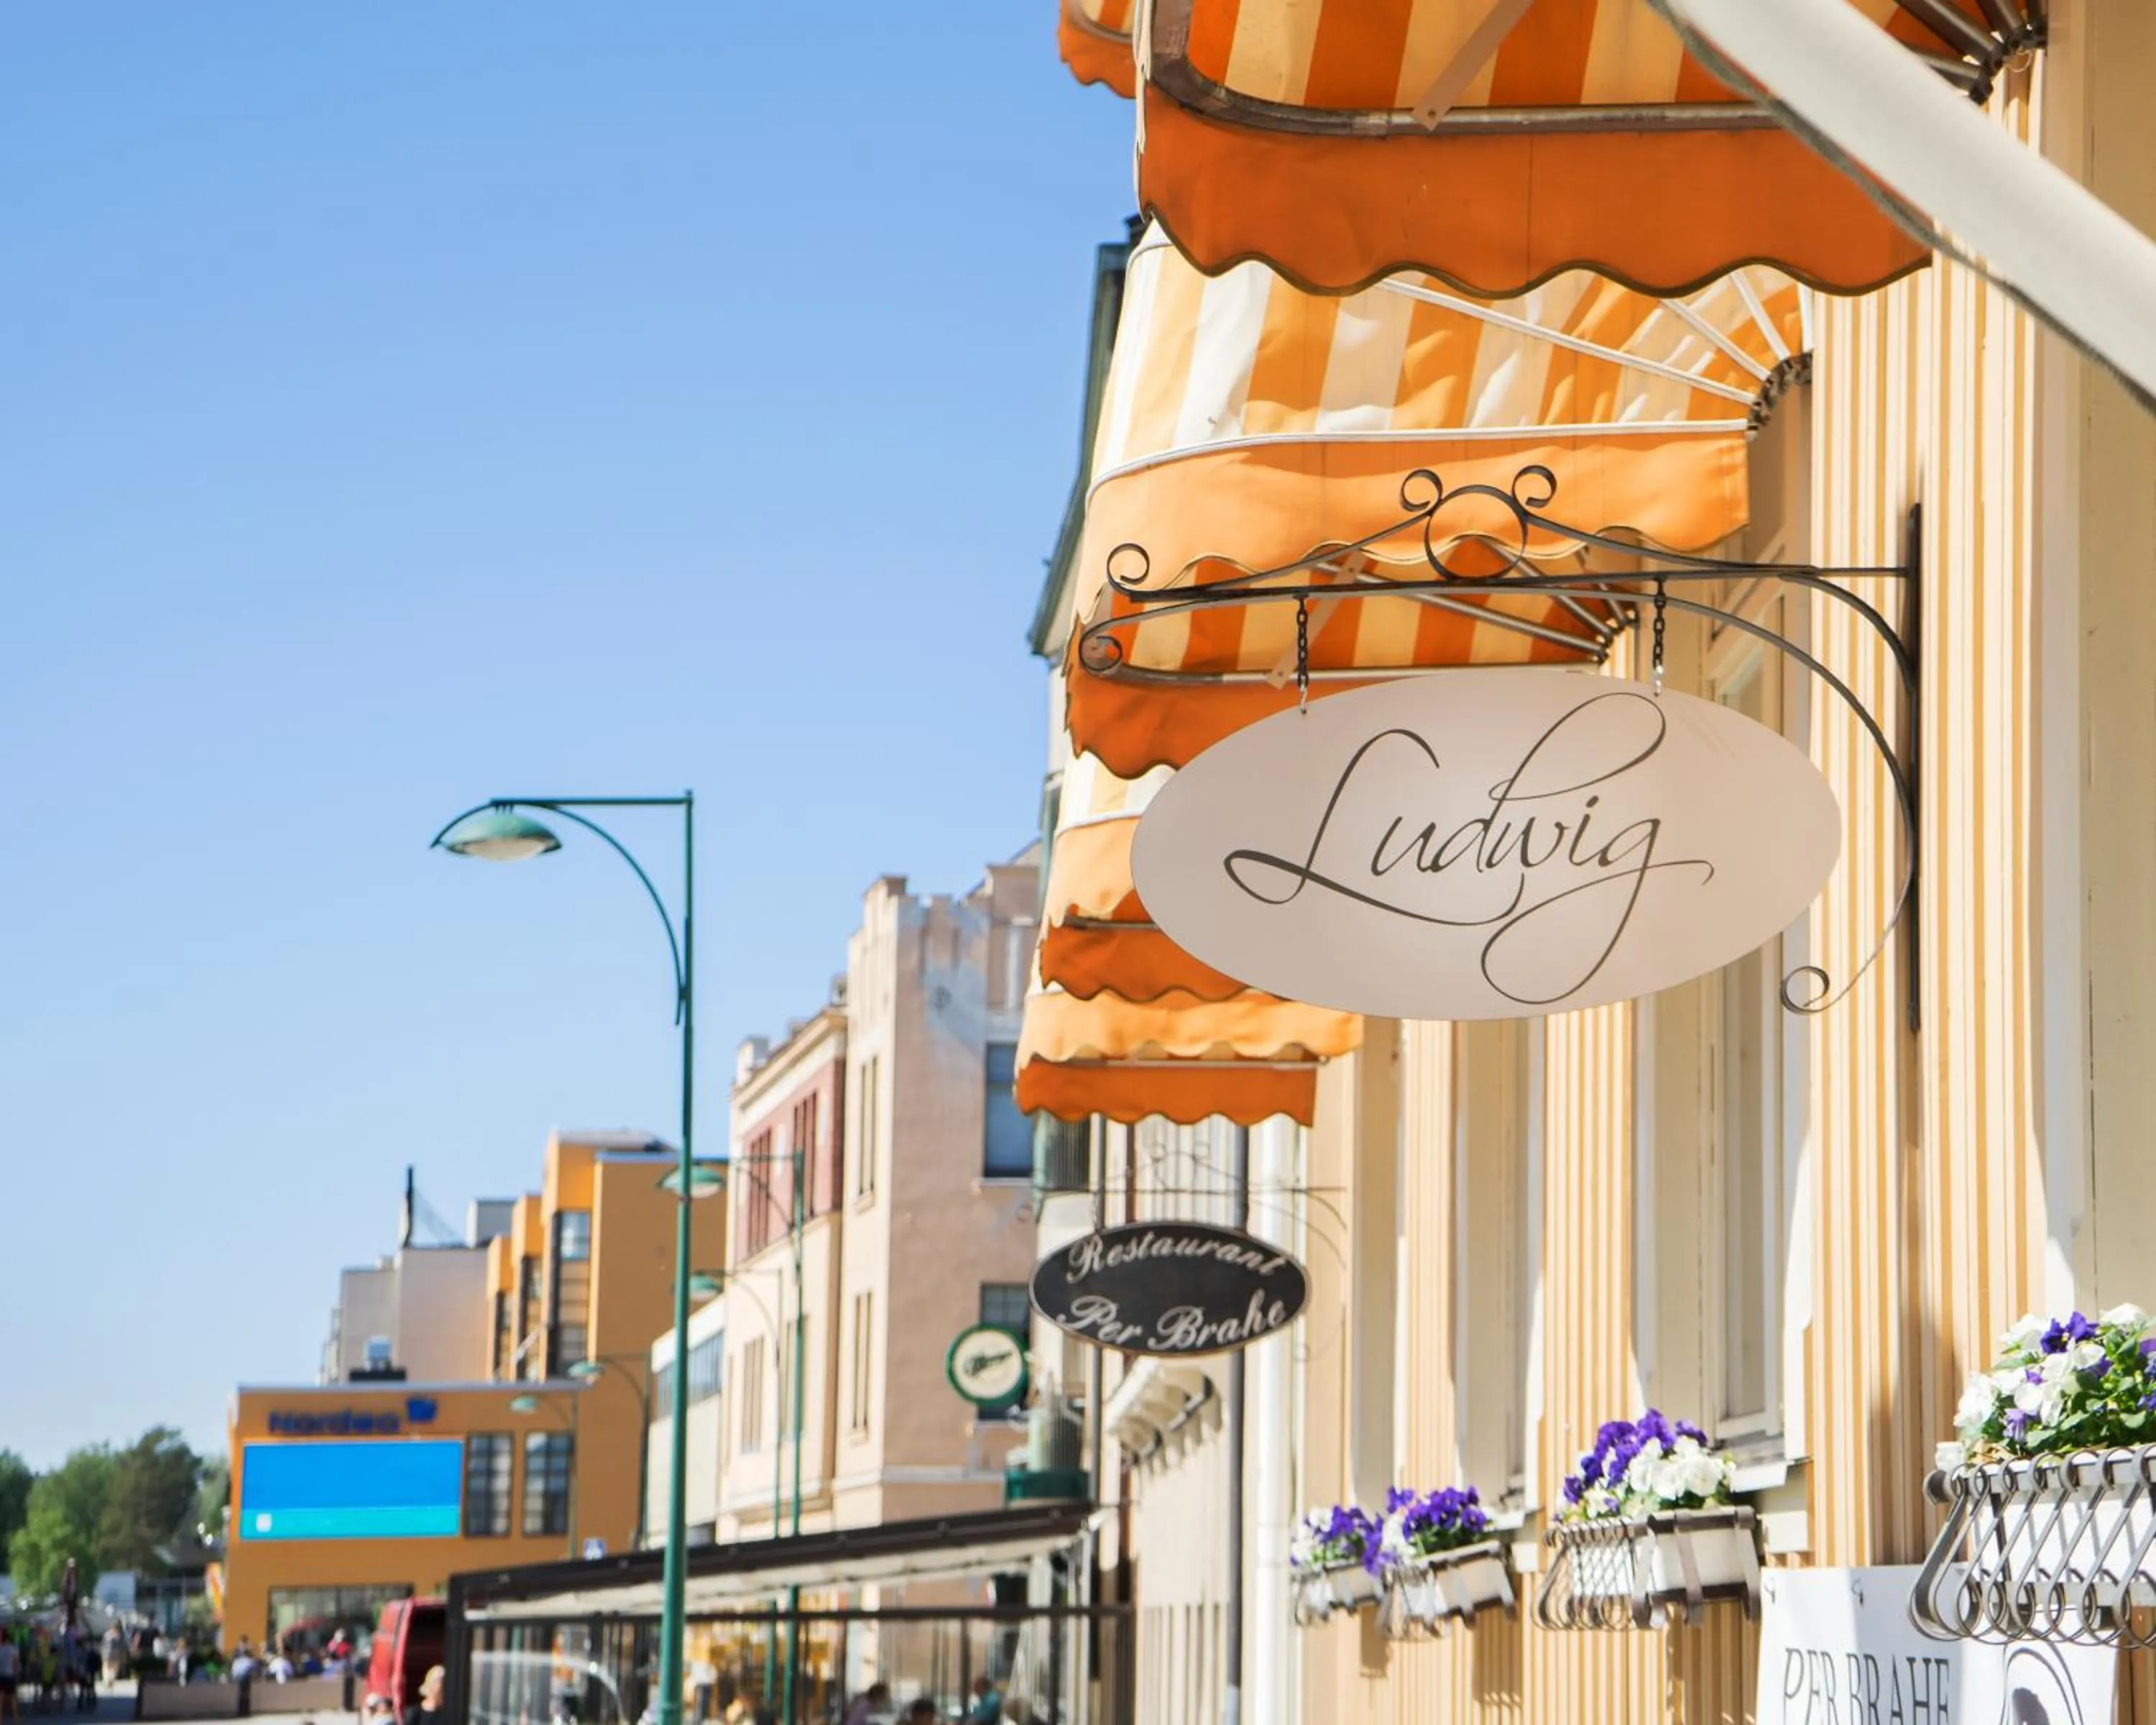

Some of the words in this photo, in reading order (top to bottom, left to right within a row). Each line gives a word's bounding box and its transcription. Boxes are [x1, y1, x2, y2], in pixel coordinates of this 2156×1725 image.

[1223, 691, 1715, 1005] Ludwig
[1066, 1230, 1287, 1284] Restaurant
[1055, 1294, 1142, 1345] Per
[1148, 1288, 1287, 1351] Brahe
